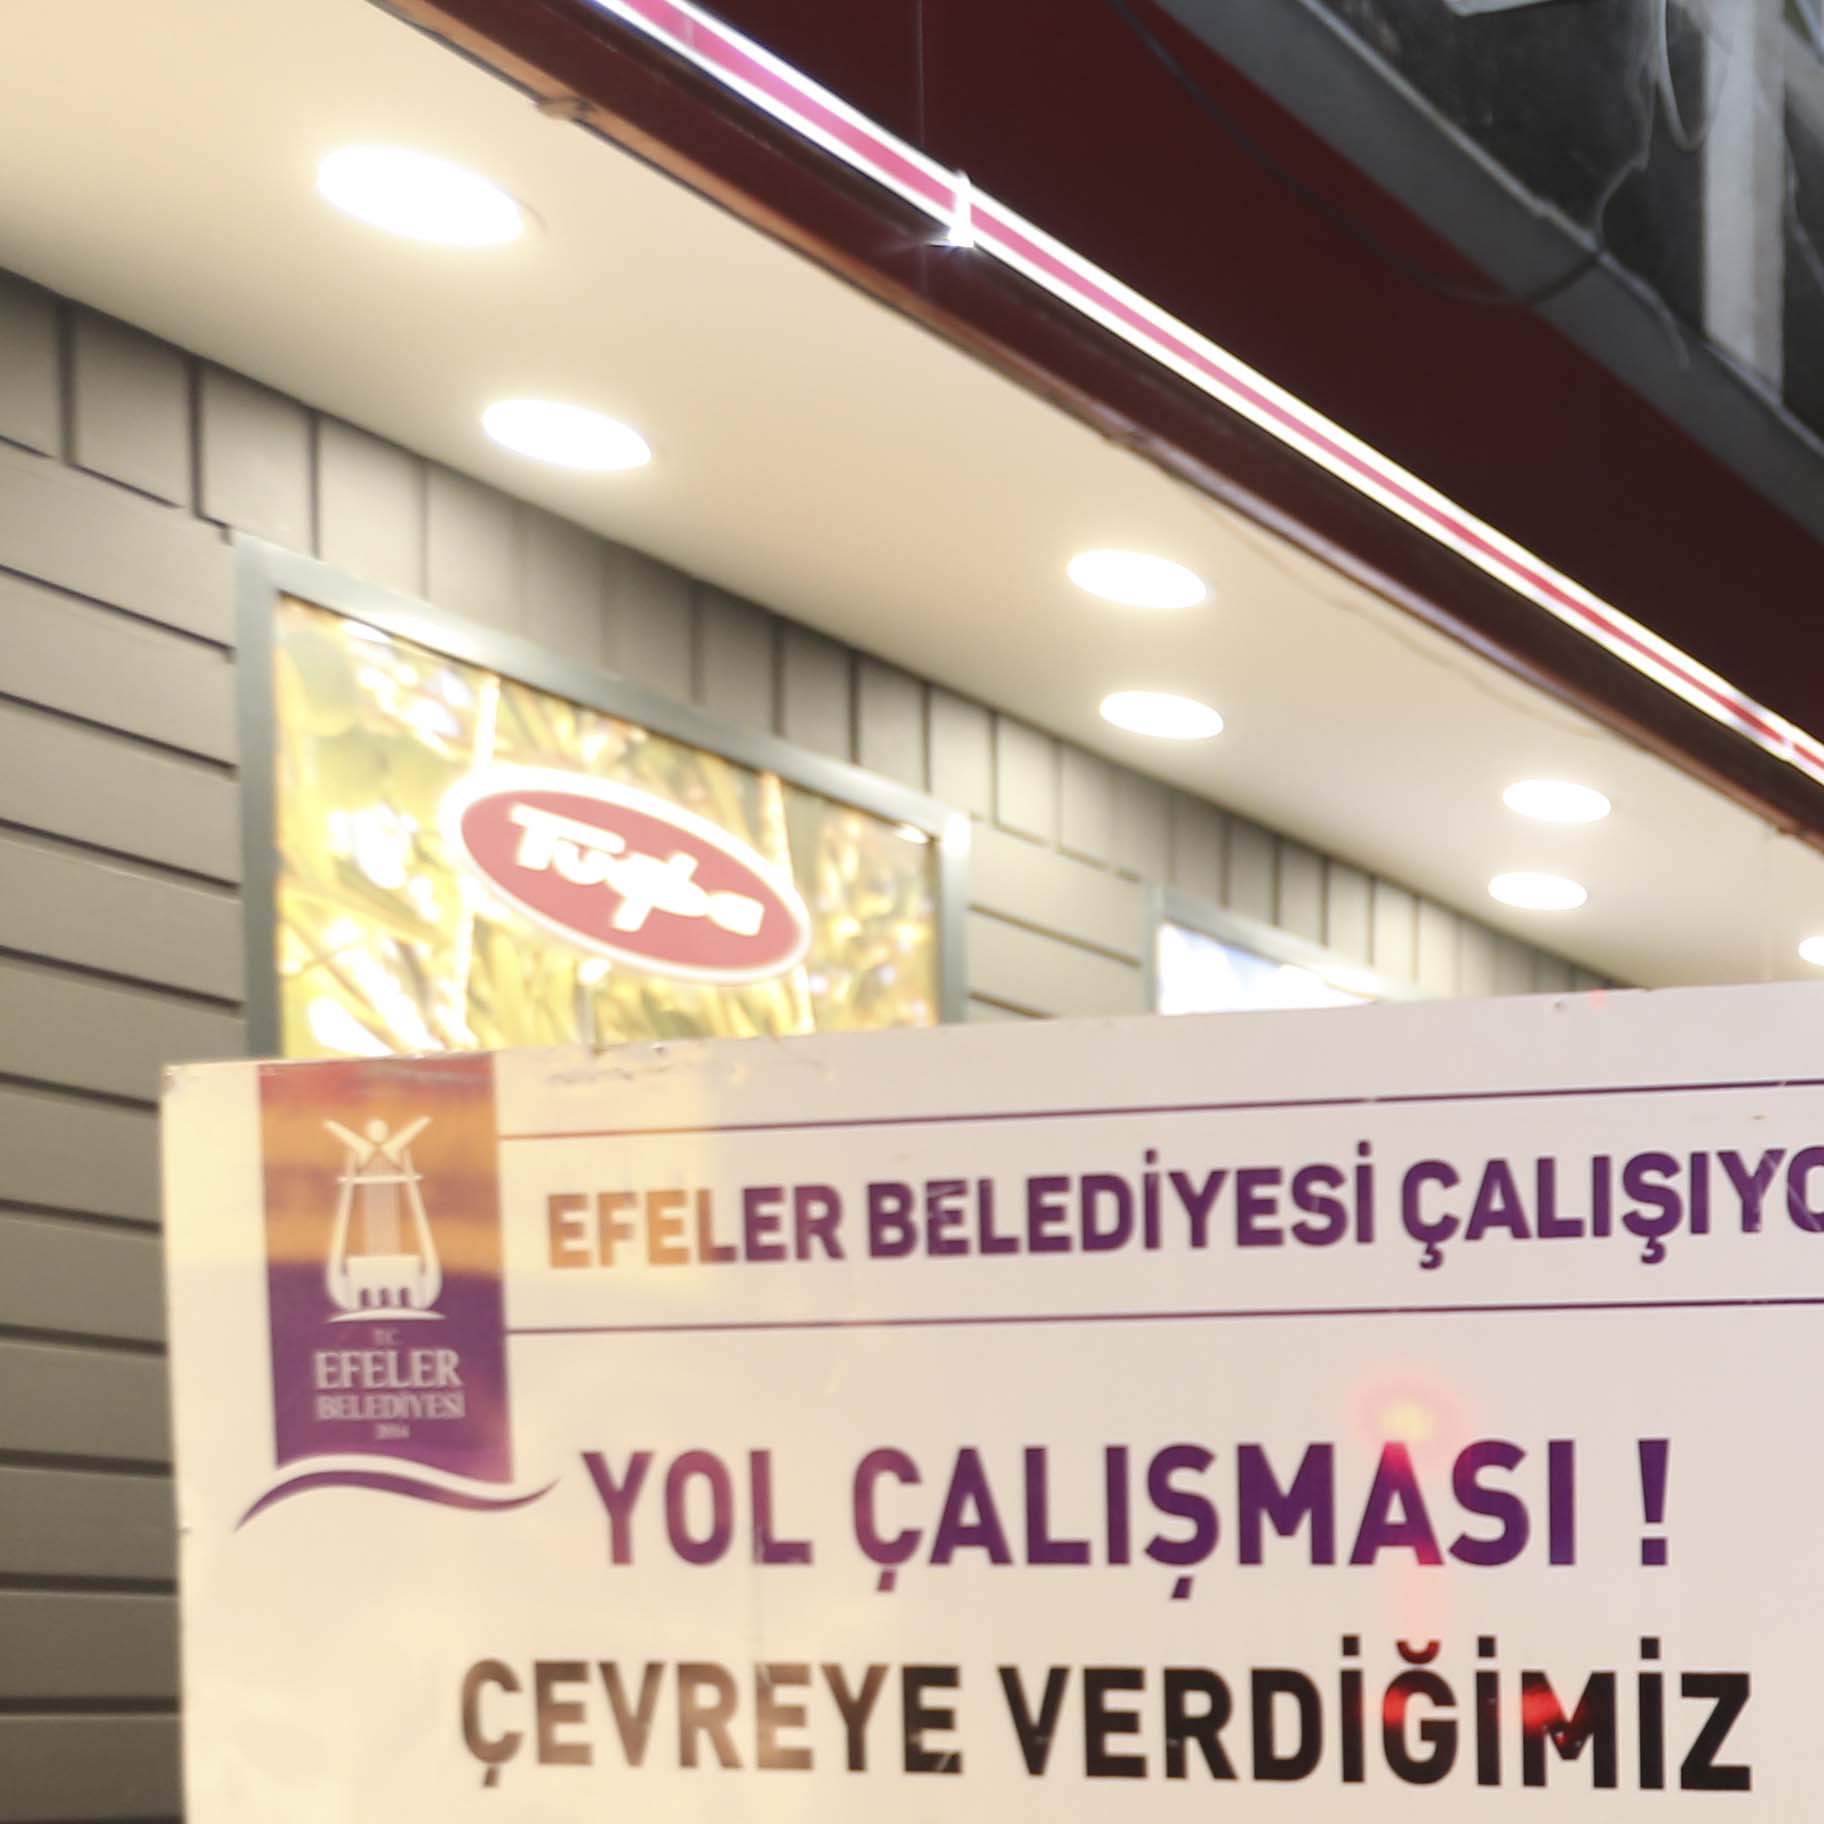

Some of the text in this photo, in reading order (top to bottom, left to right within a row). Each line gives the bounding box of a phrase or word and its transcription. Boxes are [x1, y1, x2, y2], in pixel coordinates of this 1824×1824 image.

[548, 1184, 845, 1269] EFELER
[866, 1139, 1374, 1260] BELEDİYESİ
[315, 1350, 465, 1388] EFELER
[581, 1439, 1671, 1599] YOL ÇALIŞMASI !
[461, 1635, 1753, 1791] ÇEVREYE VERDİĞİMİZ
